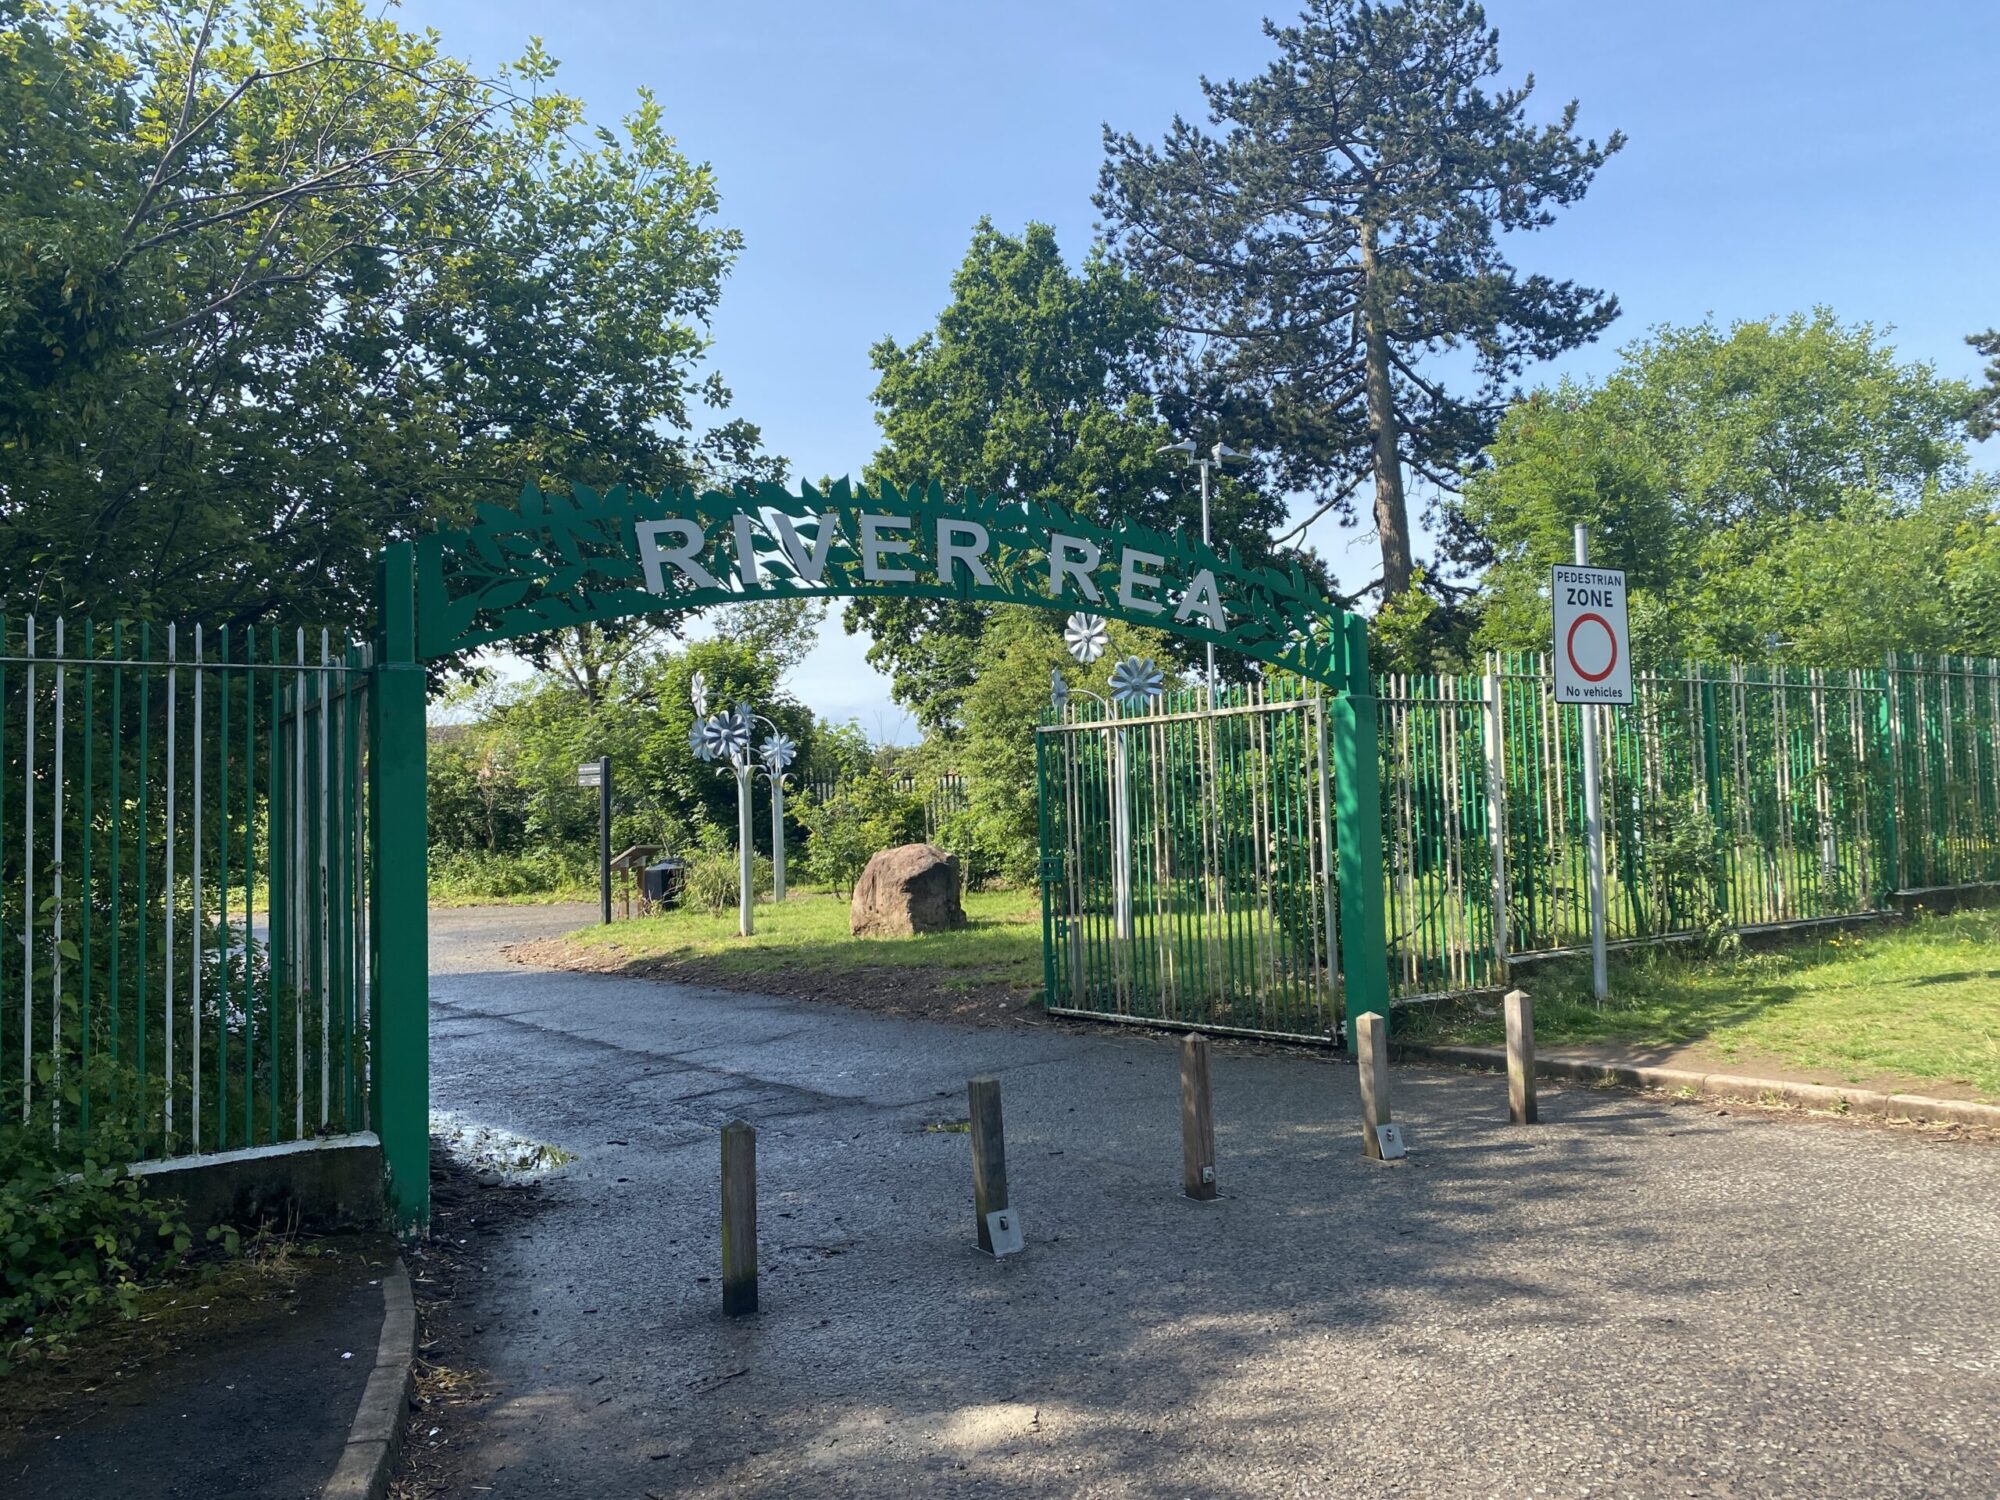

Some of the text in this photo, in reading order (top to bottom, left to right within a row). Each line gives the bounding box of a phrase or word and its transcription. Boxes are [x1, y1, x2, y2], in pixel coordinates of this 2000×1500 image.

[634, 512, 1228, 633] RIVER REA
[1557, 571, 1622, 586] PEDESTRIAN
[1566, 588, 1613, 607] ZONE
[1566, 685, 1623, 698] No vehicles
